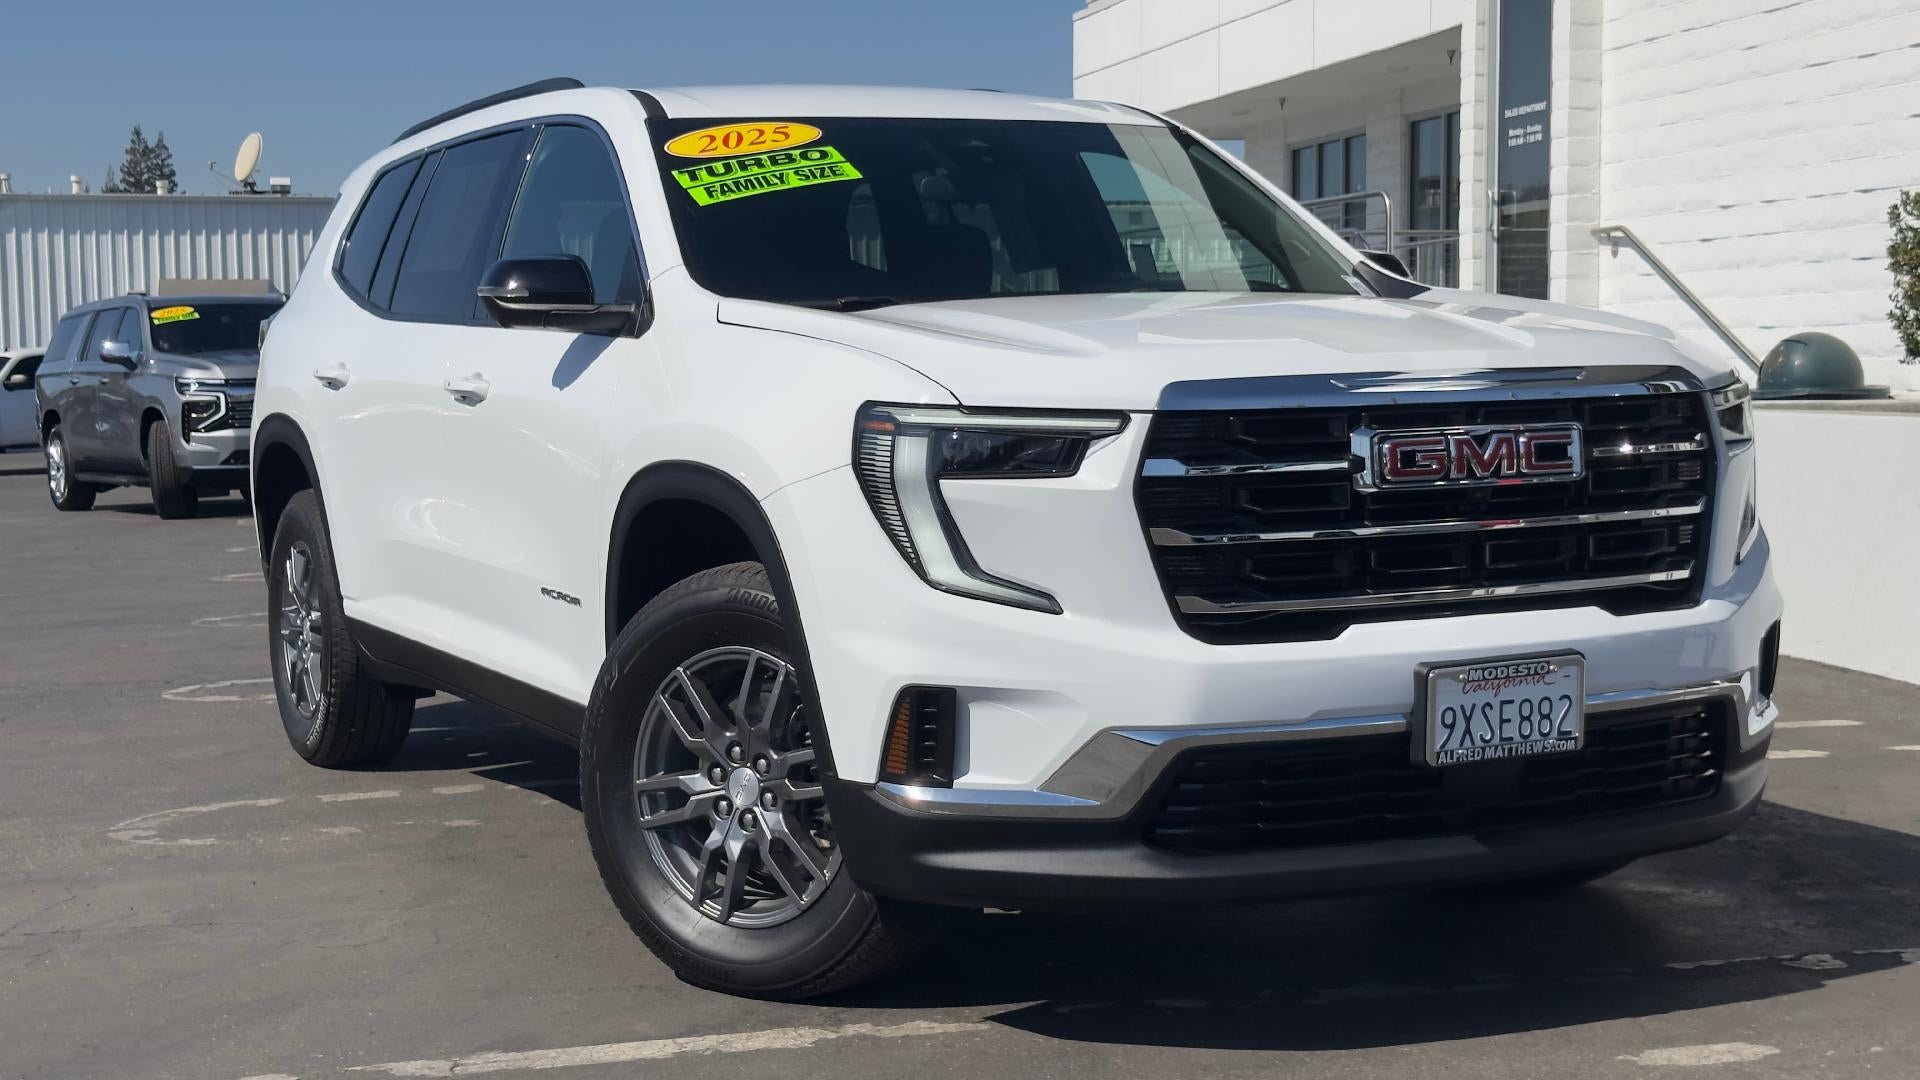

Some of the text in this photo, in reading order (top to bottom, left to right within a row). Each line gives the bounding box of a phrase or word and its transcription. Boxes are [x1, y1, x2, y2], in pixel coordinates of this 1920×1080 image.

[698, 126, 791, 153] 2025
[678, 149, 832, 183] TURBO
[704, 165, 844, 200] FAMILY SIZE
[1382, 430, 1575, 481] GMC
[1462, 673, 1556, 698] California
[1468, 662, 1550, 681] MODESTO
[1437, 694, 1573, 750] 9XSE882
[1438, 748, 1484, 765] ALFRED
